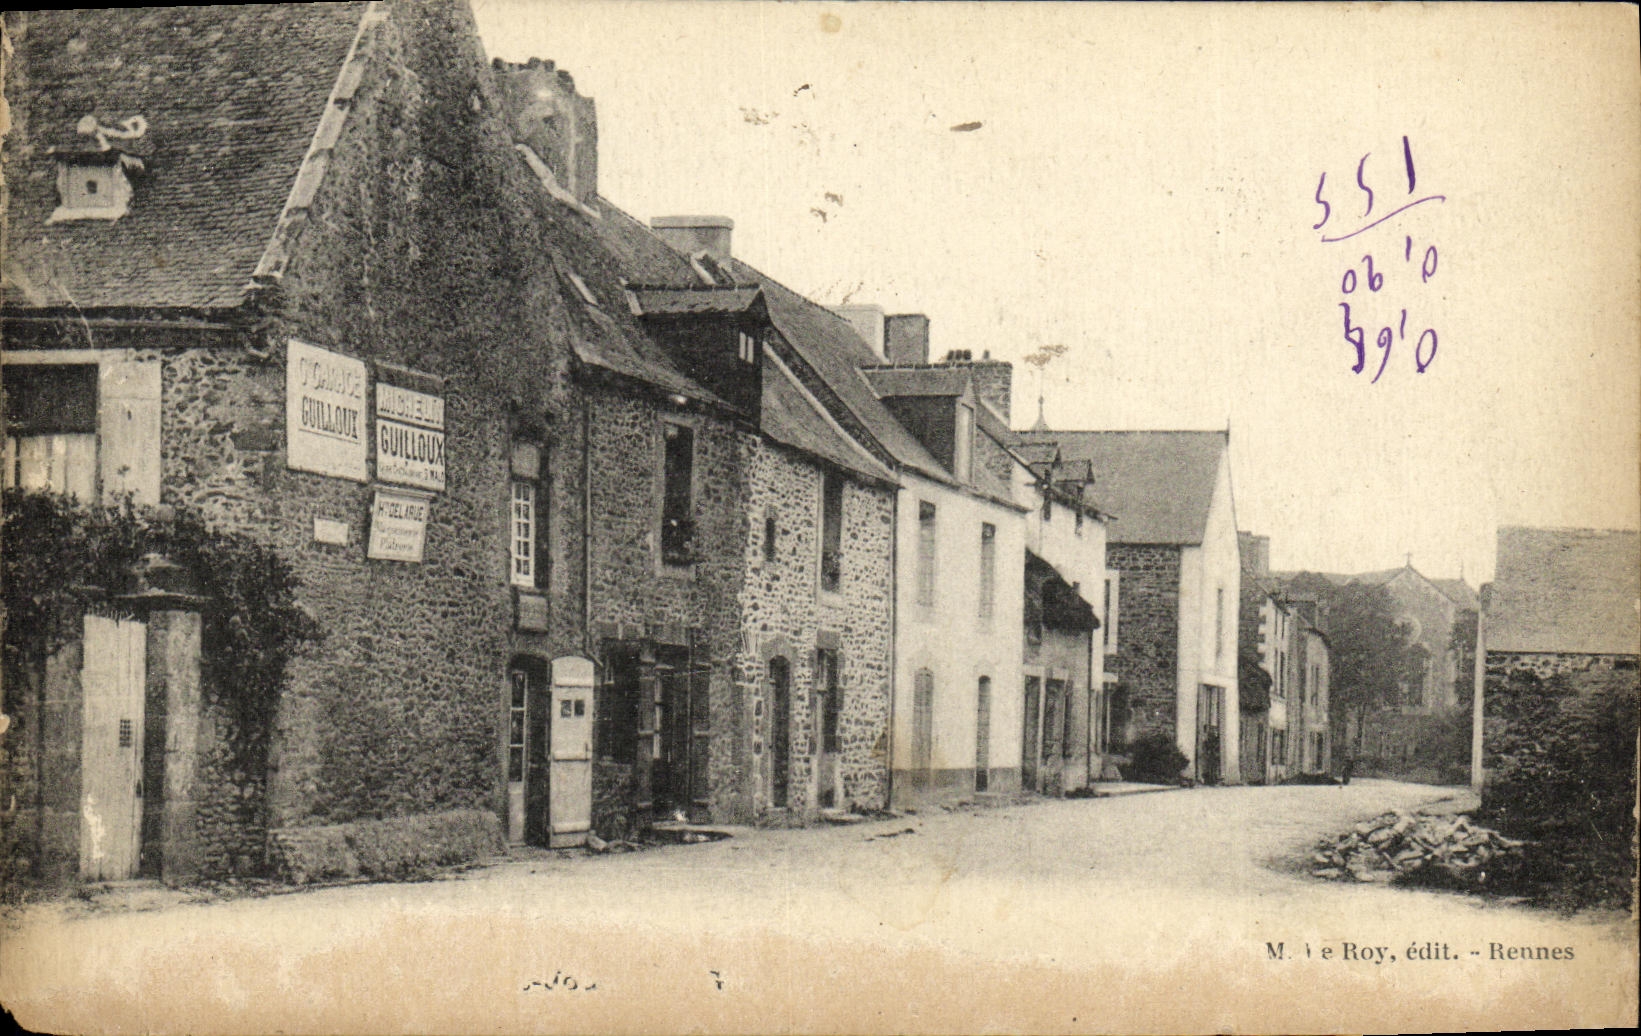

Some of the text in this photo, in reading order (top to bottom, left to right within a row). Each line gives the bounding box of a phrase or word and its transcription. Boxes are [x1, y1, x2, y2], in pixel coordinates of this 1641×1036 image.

[302, 395, 358, 439] GUILLOUX
[379, 386, 442, 424] MICHELIN
[381, 425, 444, 466] GUILLOUX
